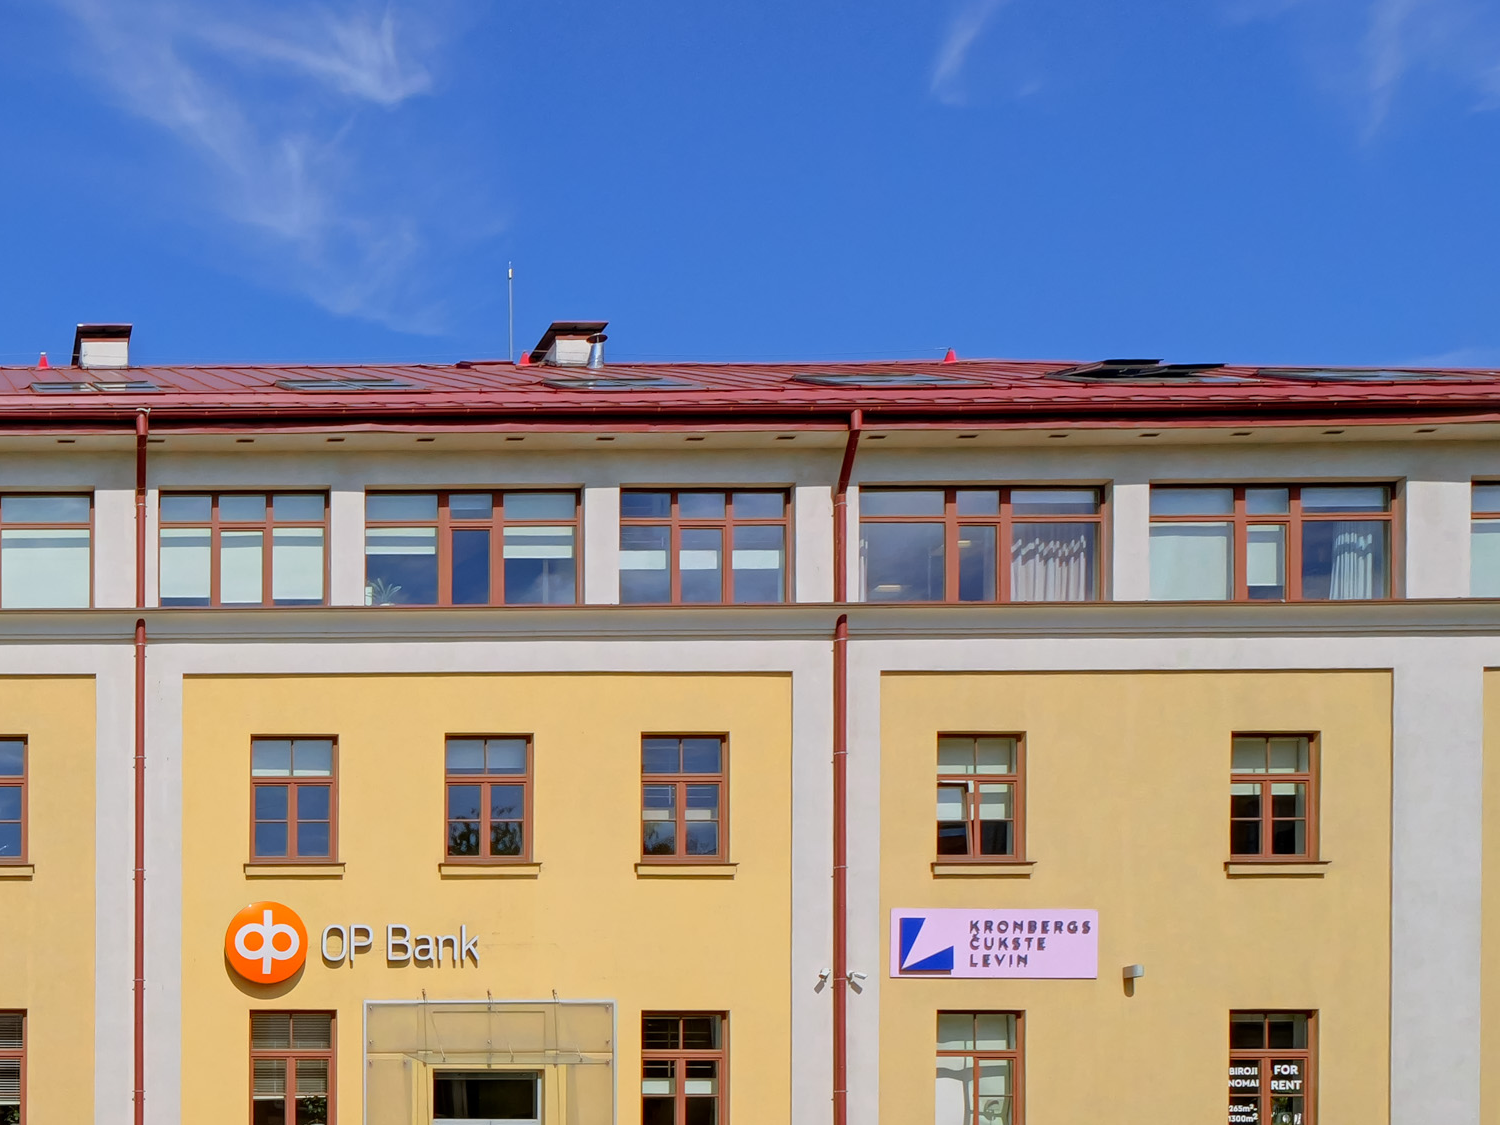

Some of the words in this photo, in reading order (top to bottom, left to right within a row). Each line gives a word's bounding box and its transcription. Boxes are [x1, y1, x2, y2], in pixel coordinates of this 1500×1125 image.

[969, 920, 1091, 934] KRONBERGS
[321, 924, 374, 961] OP
[386, 924, 480, 961] Bank
[969, 932, 1047, 951] ČUKSTE
[969, 954, 1028, 968] LEVIN
[1229, 1067, 1258, 1076] BIROJI
[1274, 1065, 1299, 1075] FOR
[1228, 1079, 1260, 1088] NOMAI
[1270, 1080, 1302, 1090] RENT
